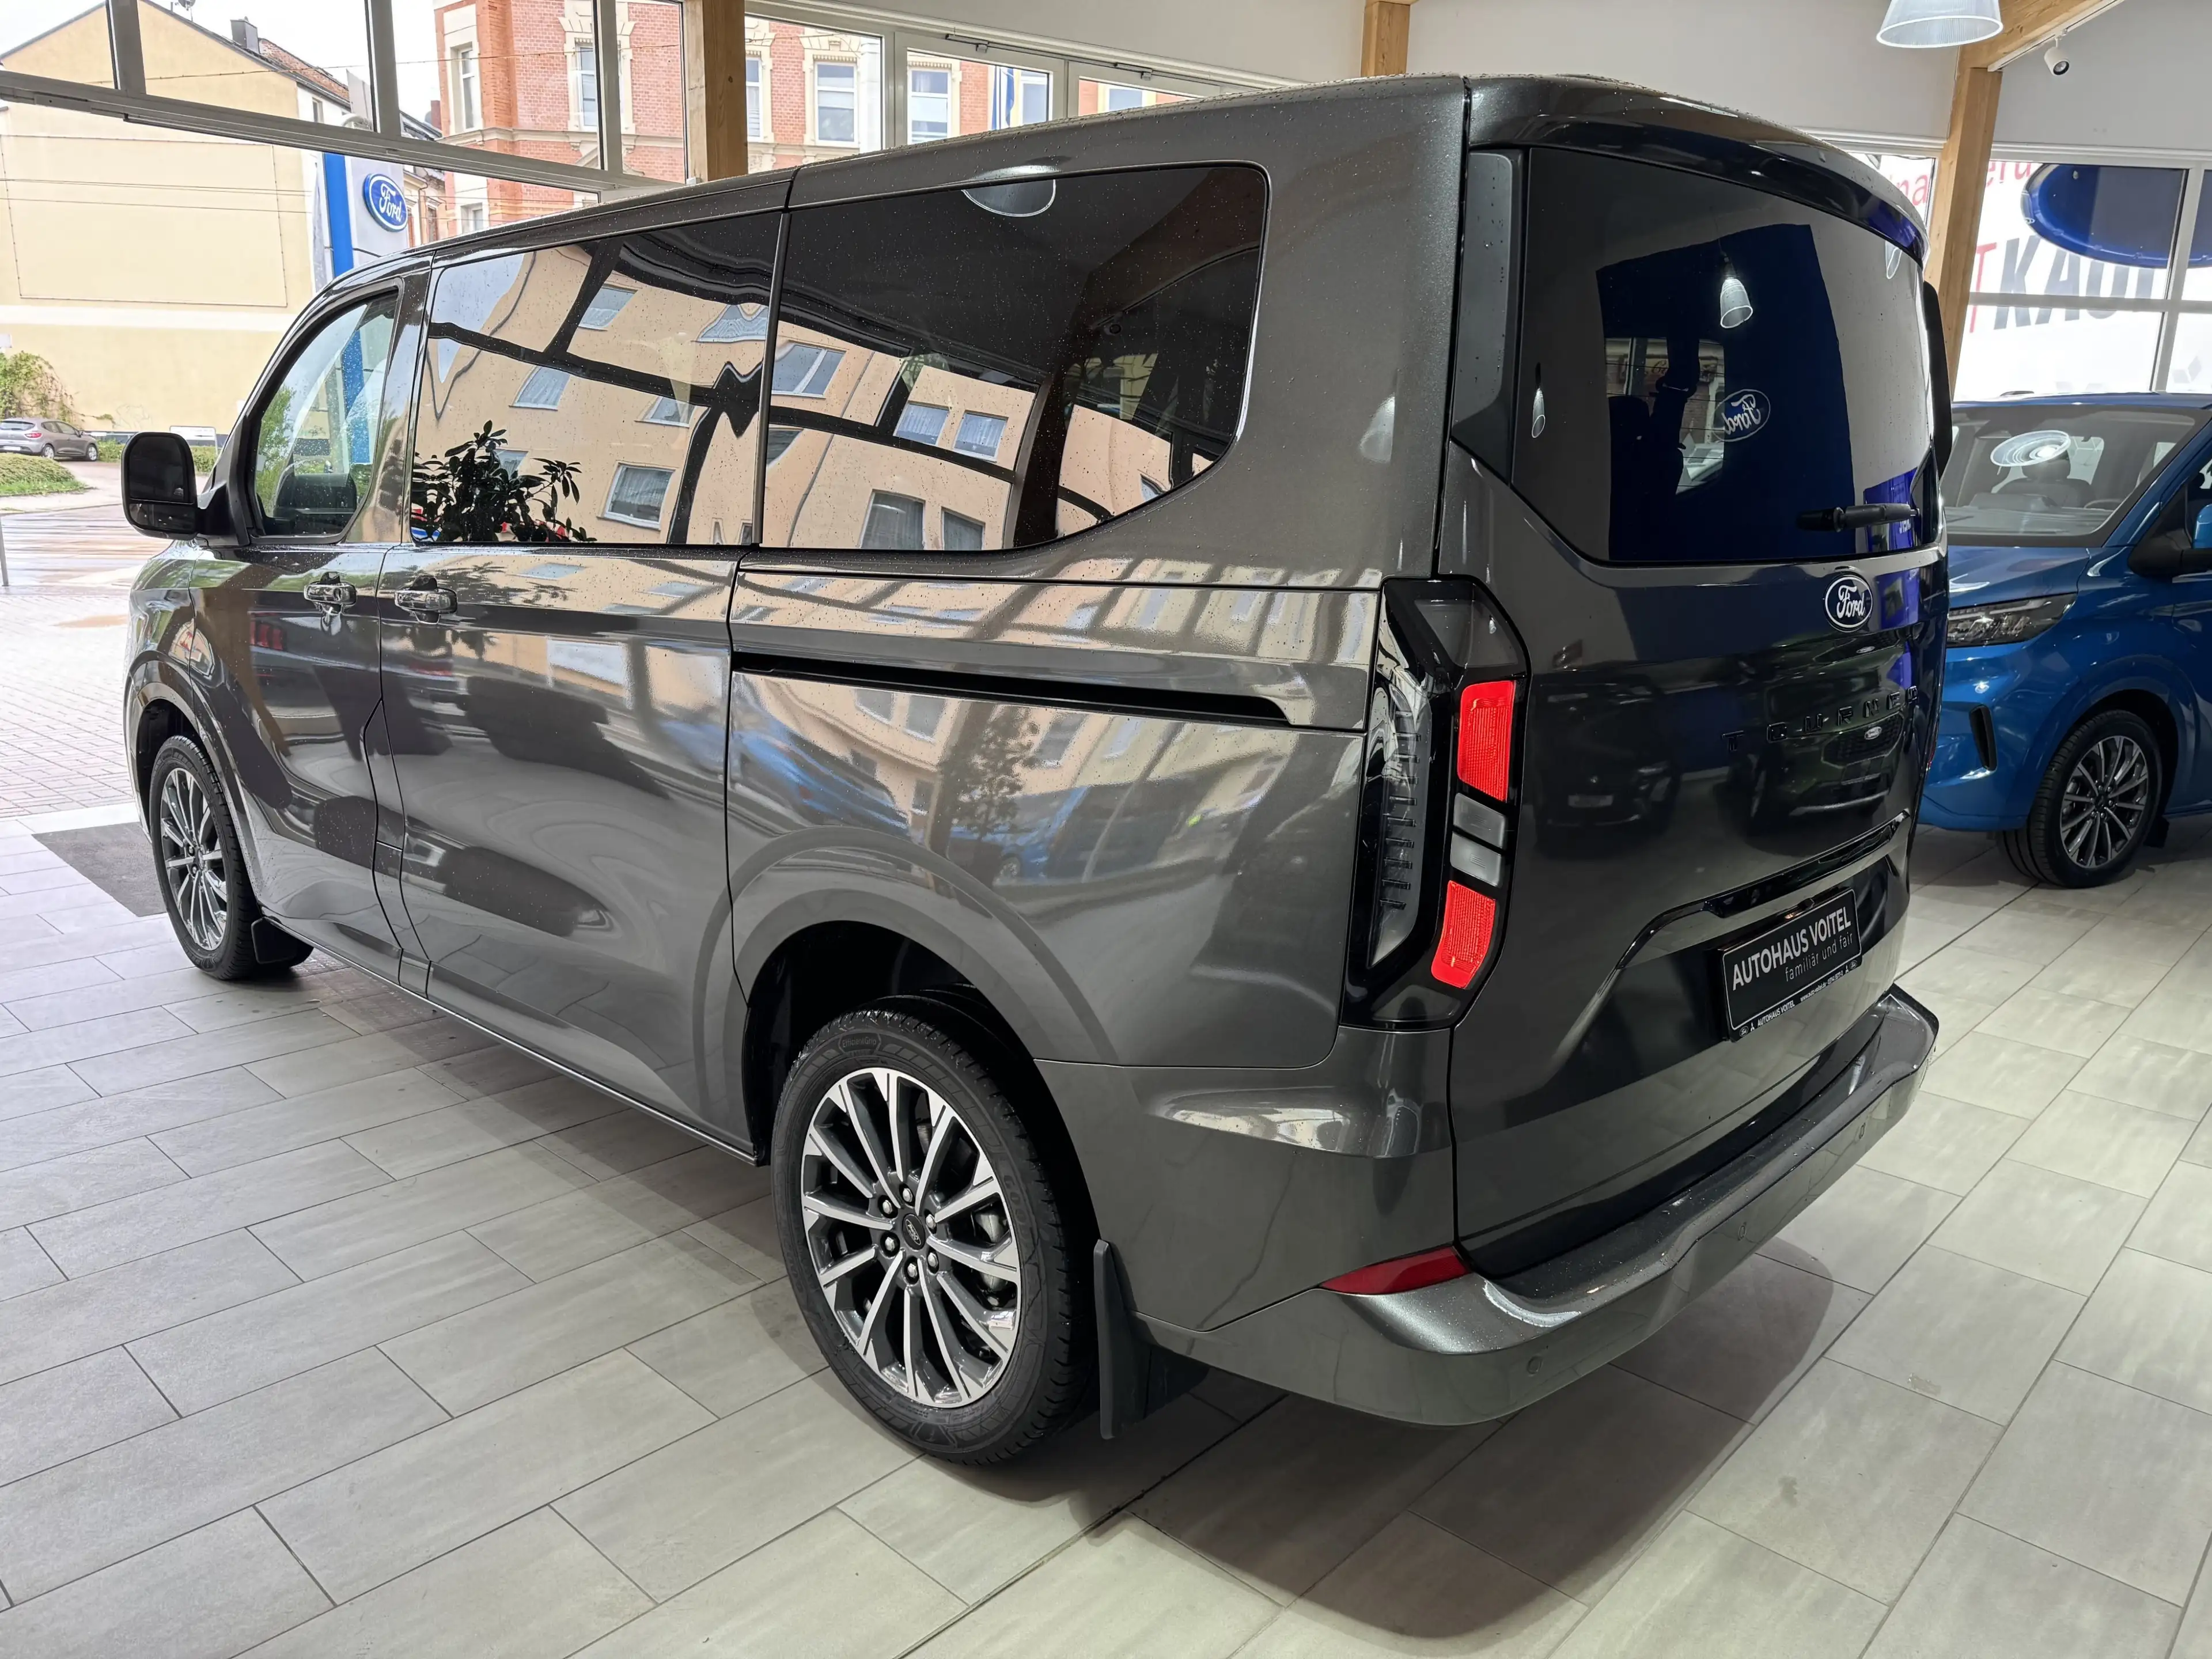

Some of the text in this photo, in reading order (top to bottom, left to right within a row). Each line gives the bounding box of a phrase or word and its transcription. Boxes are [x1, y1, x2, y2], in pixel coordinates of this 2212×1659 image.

[378, 183, 403, 222] Ford
[1836, 585, 1866, 619] Ford
[1721, 685, 1919, 752] TOURNEO
[1732, 906, 1851, 991] AUTOHAUS VOITEL
[1822, 939, 1837, 961] und
[1839, 931, 1853, 948] fair
[1757, 1007, 1781, 1027] AUTOHAUS
[1781, 999, 1796, 1015] VOITEL
